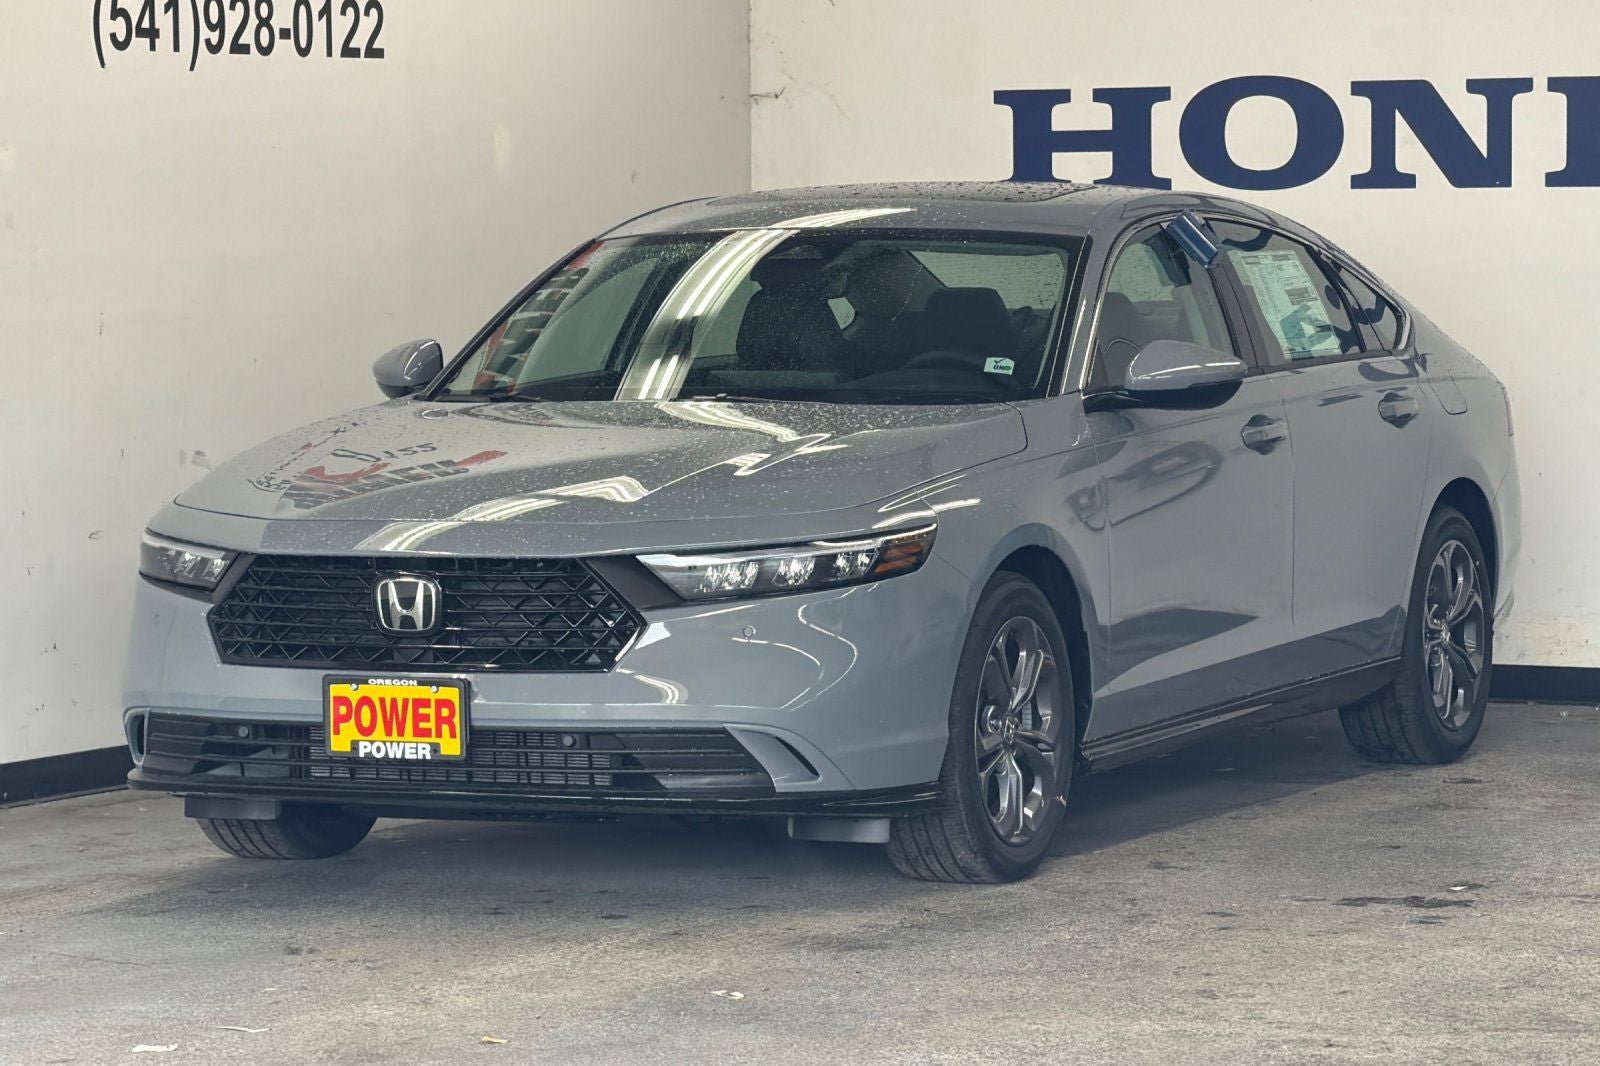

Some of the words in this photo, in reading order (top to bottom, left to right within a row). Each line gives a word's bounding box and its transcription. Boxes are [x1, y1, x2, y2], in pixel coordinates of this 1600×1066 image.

[93, 0, 384, 71] (541)928-0122
[368, 678, 418, 686] OREGON
[332, 696, 457, 739] POWER
[359, 741, 431, 760] POWER
